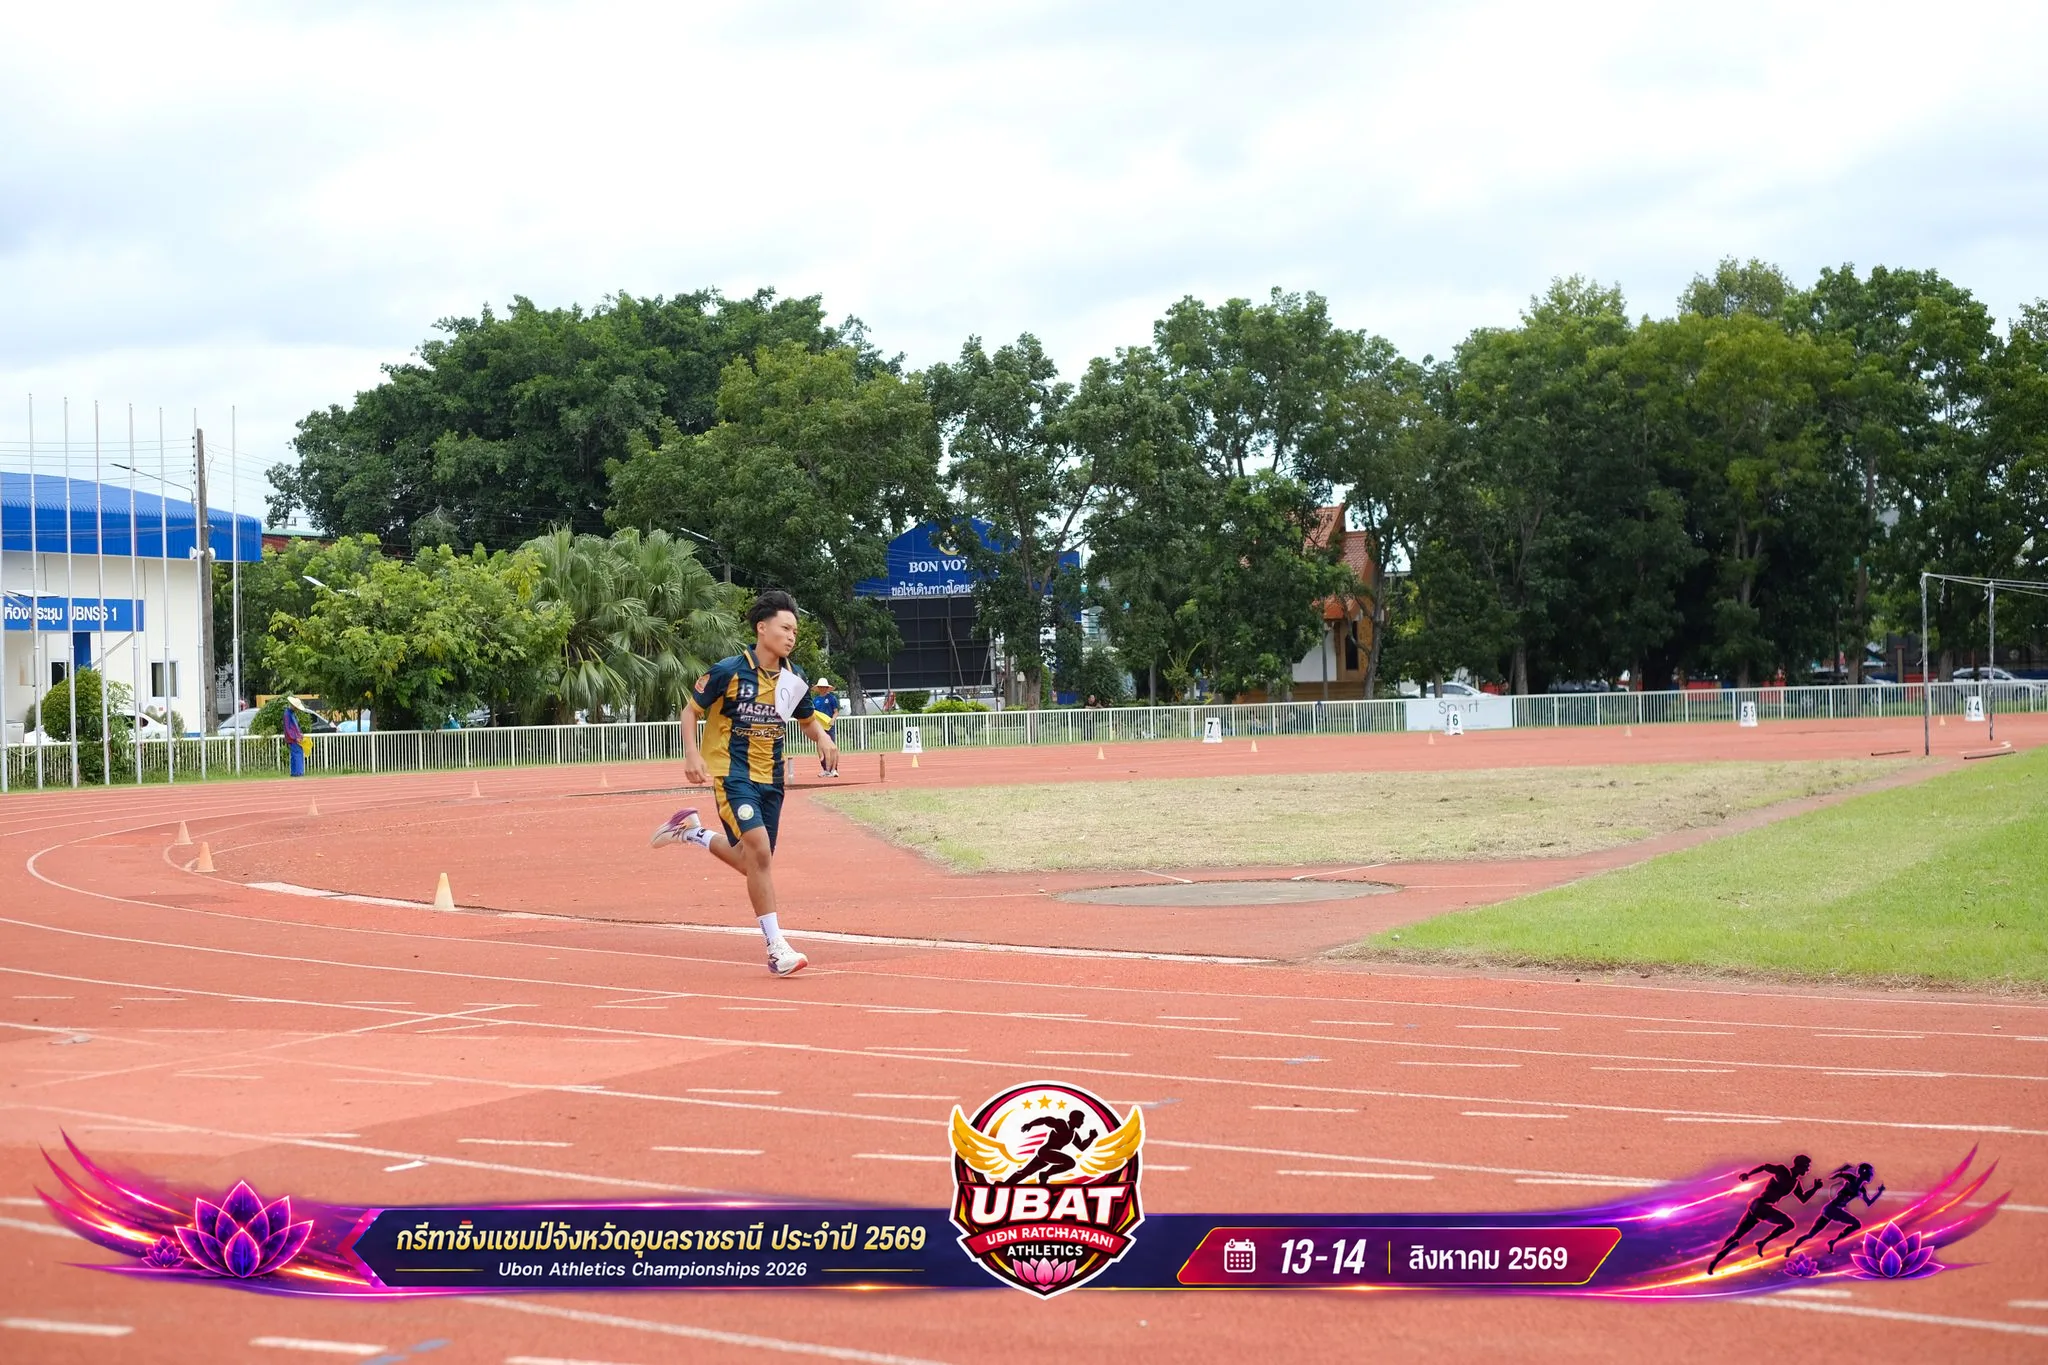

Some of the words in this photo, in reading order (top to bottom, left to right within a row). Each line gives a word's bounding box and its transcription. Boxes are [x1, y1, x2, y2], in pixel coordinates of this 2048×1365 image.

[908, 561, 939, 573] BON
[111, 607, 118, 621] 1
[740, 684, 755, 698] 13
[1743, 706, 1748, 717] 5
[1452, 713, 1458, 726] 6
[1207, 721, 1213, 734] 7
[906, 730, 912, 743] 8
